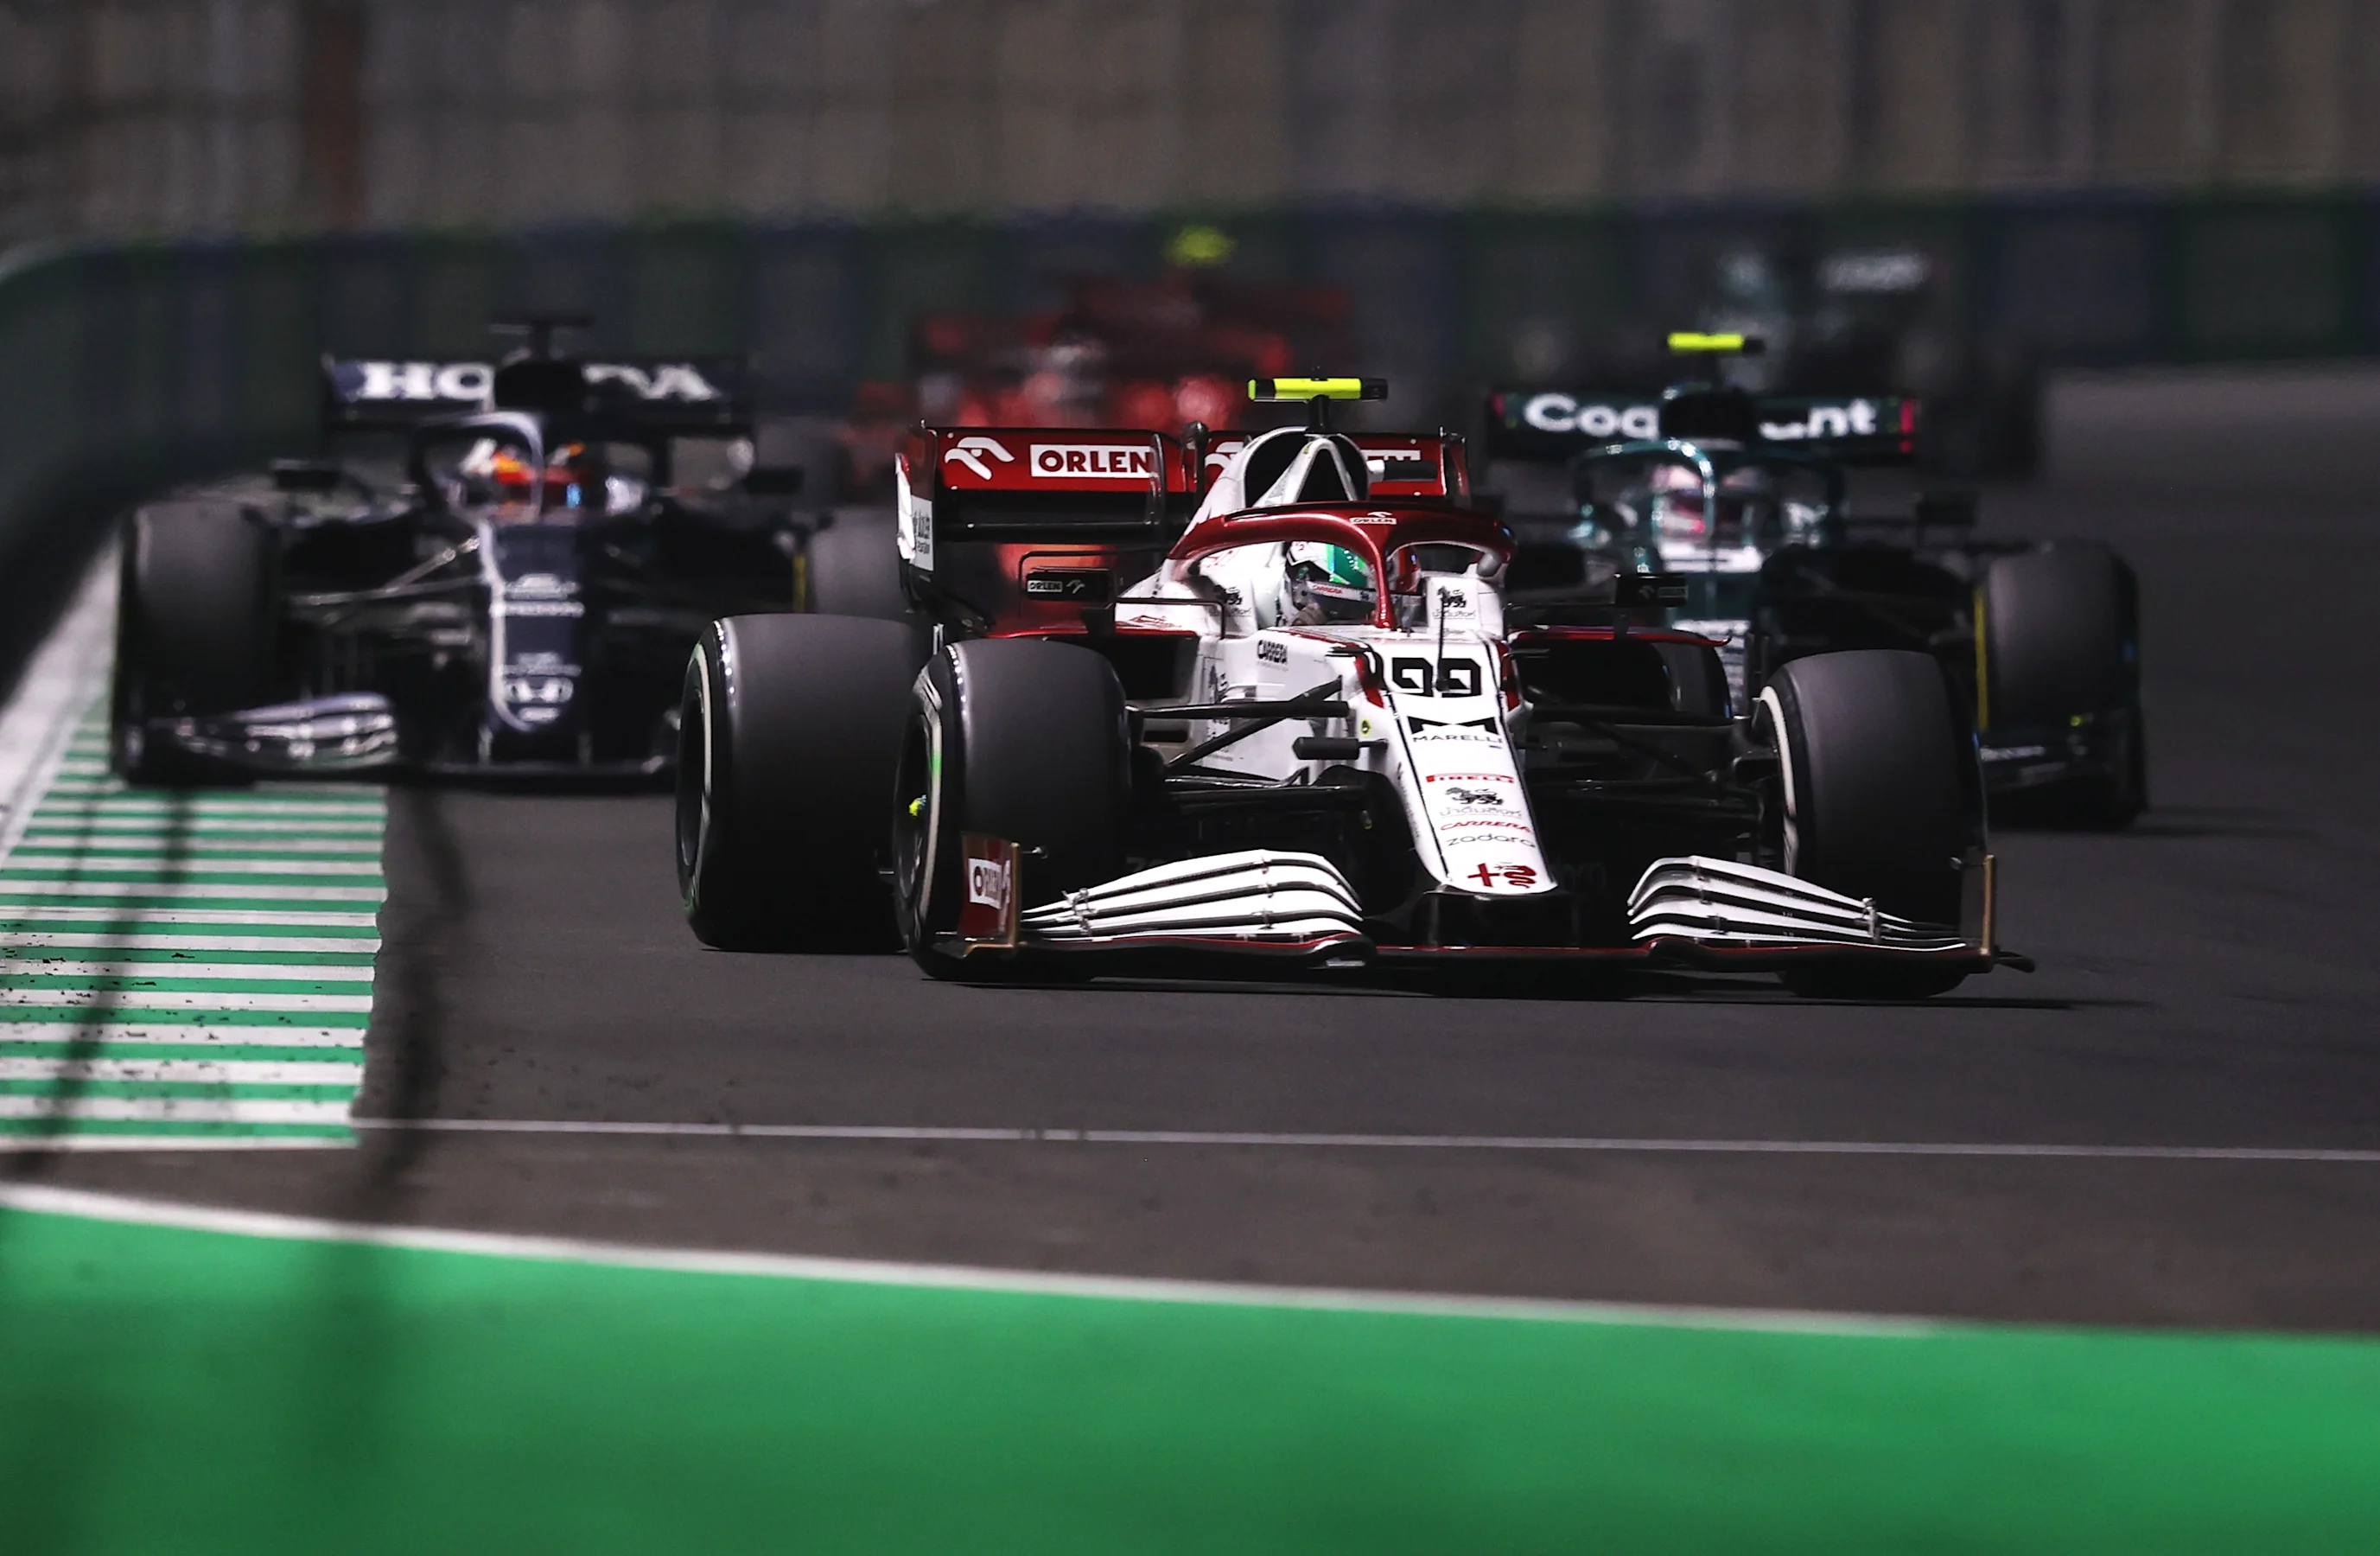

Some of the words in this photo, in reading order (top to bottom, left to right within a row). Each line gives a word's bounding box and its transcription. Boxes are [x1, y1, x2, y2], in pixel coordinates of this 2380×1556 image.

[1039, 450, 1155, 474] ORLEN
[1391, 657, 1482, 698] 99
[1412, 735, 1503, 743] MARELLI
[1441, 820, 1531, 832] CARRERA
[1447, 833, 1536, 848] zadara
